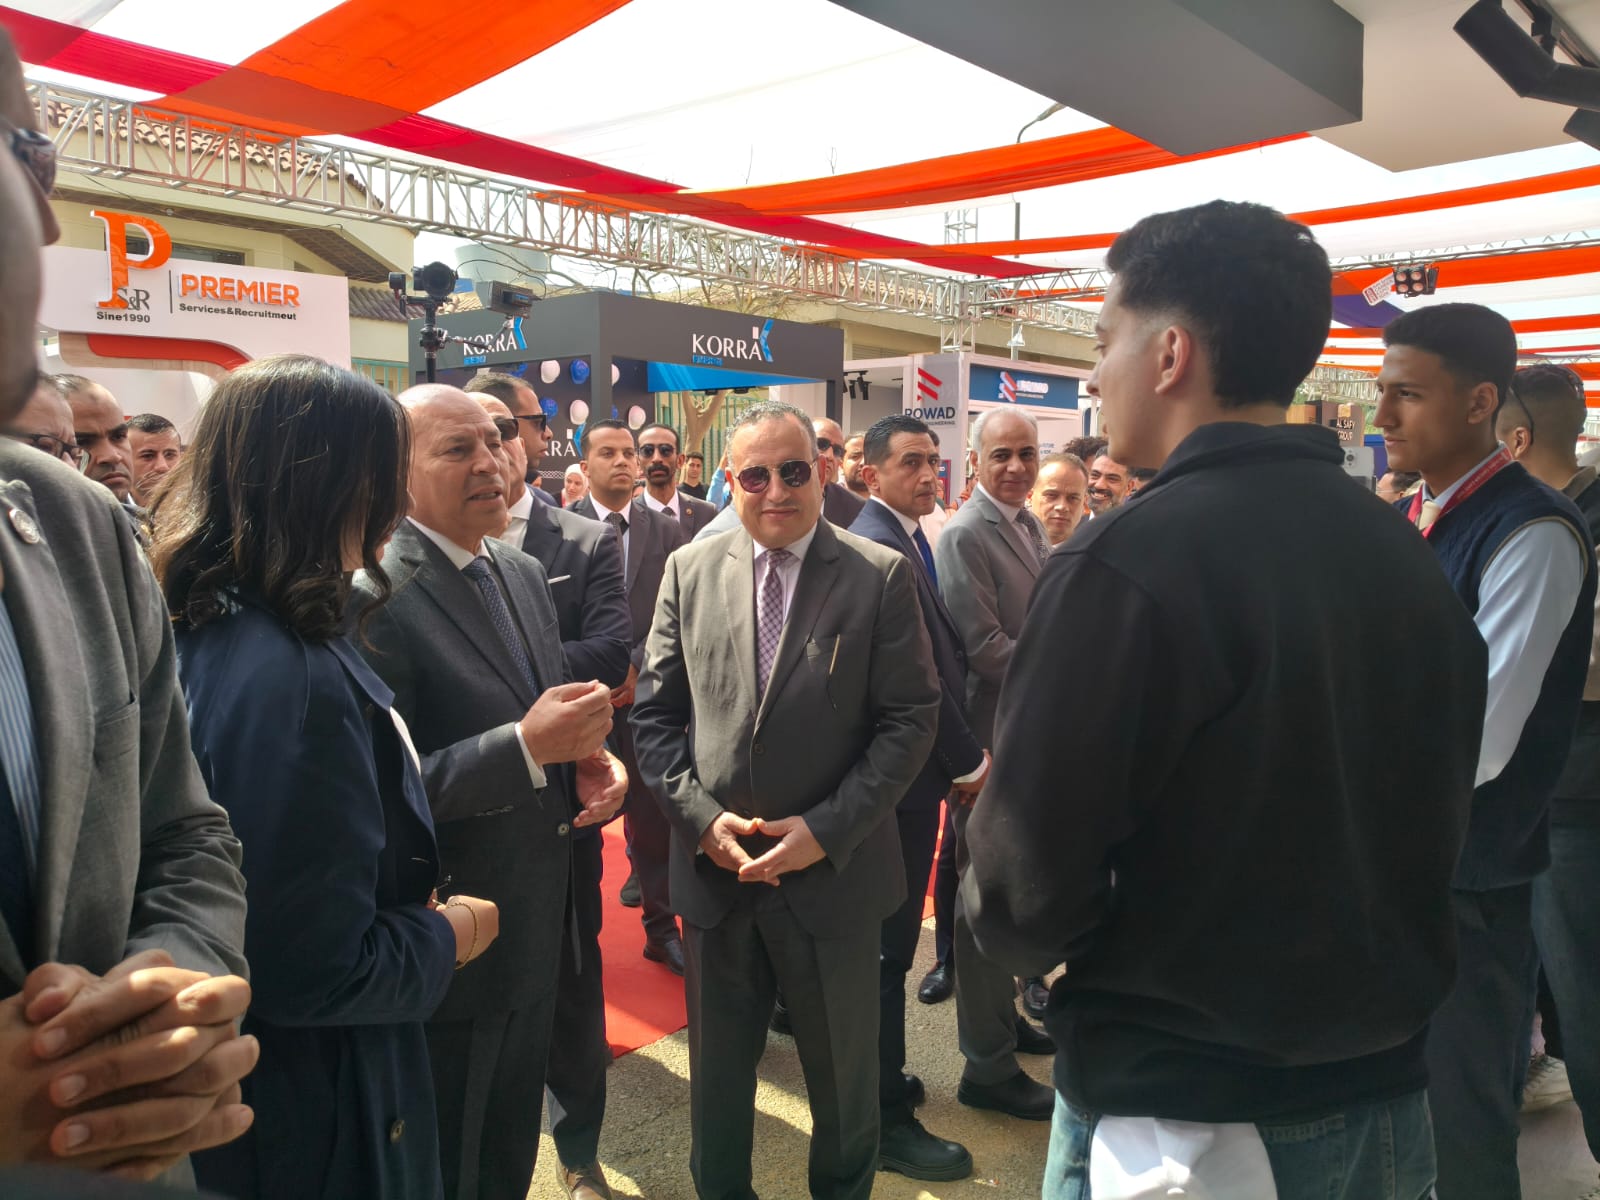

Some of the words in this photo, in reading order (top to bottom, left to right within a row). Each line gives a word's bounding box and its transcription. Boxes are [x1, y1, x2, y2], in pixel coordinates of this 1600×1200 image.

[179, 273, 300, 307] PREMIER
[96, 312, 151, 323] Sine1990
[692, 333, 762, 361] KORRA
